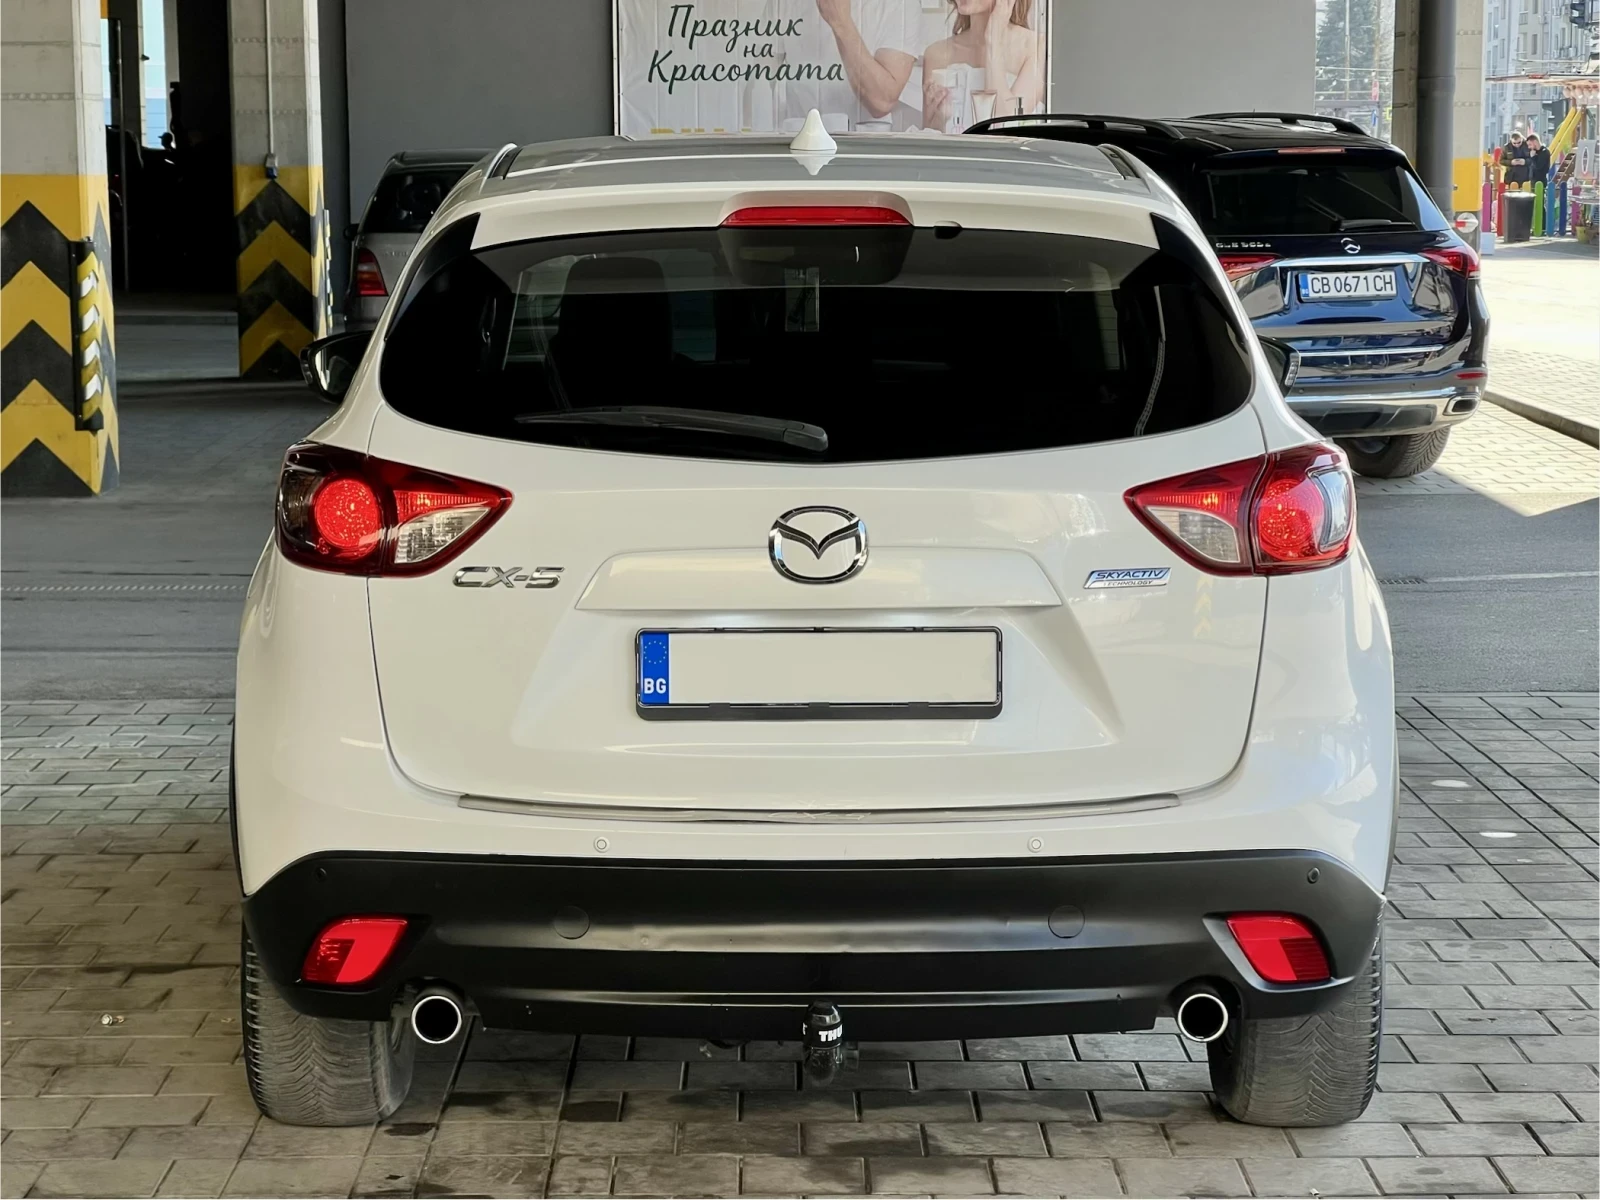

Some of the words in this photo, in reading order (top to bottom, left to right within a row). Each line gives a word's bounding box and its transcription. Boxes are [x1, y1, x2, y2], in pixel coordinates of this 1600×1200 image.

[668, 4, 803, 53] Празник
[743, 43, 774, 58] на
[647, 50, 844, 95] Красотата
[1311, 277, 1331, 294] CB
[1334, 275, 1369, 293] 0671
[1373, 275, 1394, 292] CH
[452, 566, 565, 589] CX-5
[1095, 570, 1164, 579] SKYACTIV
[643, 678, 667, 694] BG
